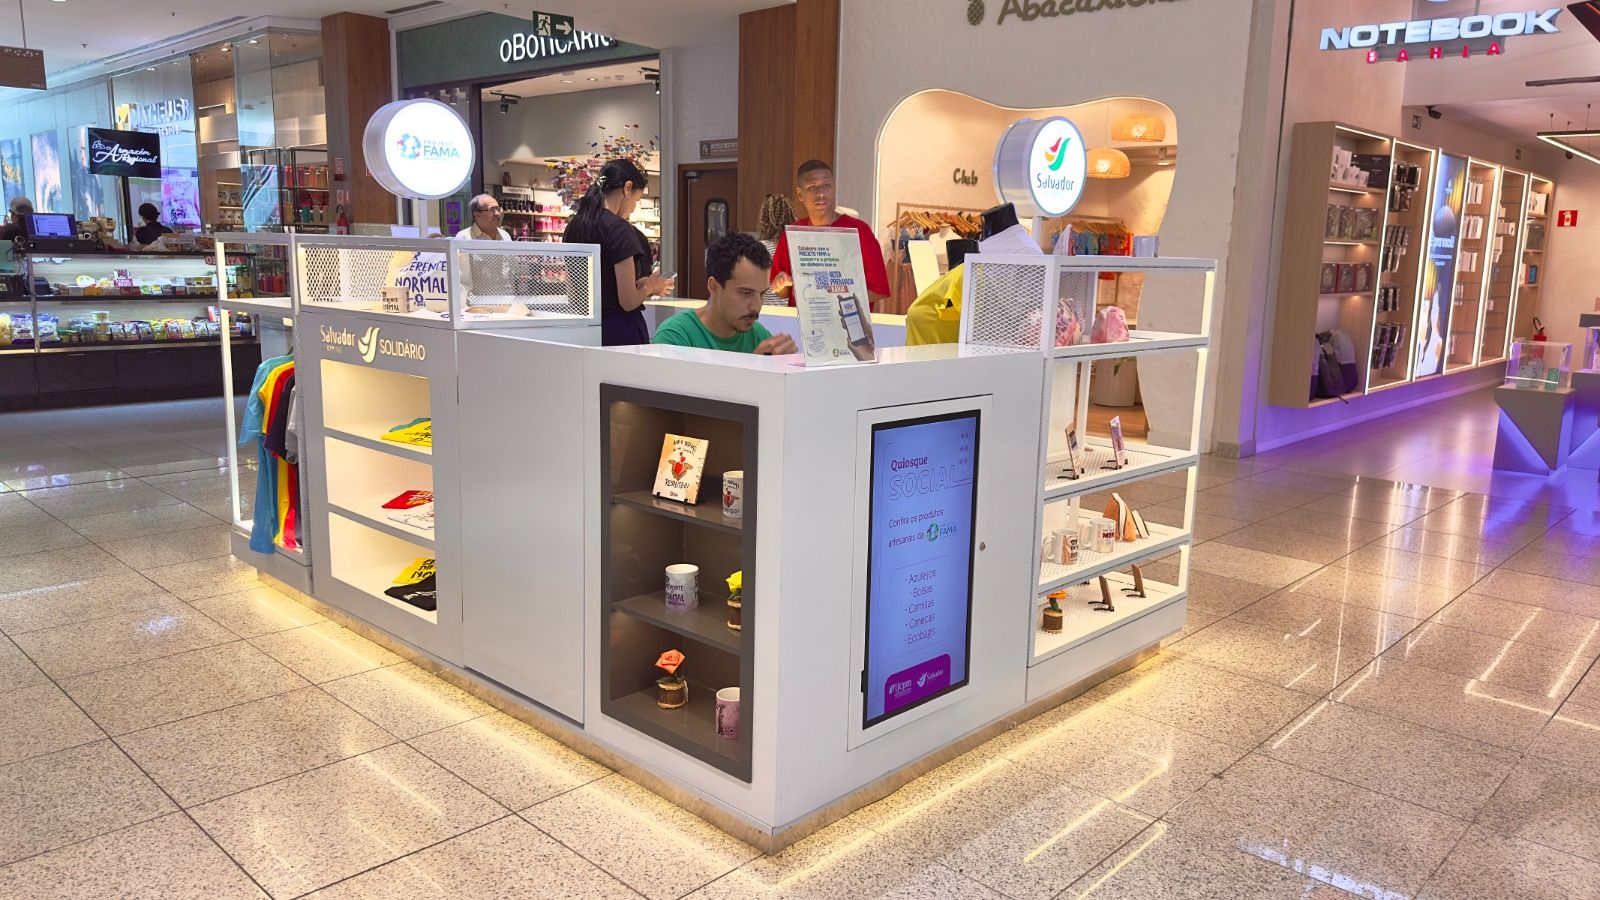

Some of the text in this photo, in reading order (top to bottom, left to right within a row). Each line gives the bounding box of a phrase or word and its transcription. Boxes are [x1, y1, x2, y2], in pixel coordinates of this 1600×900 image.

[1319, 8, 1563, 50] NOTEBOOK
[1366, 42, 1500, 64] BAHIA
[423, 145, 460, 158] FAMA
[953, 167, 978, 186] Club
[1036, 172, 1075, 191] Salvador
[394, 275, 448, 294] NORMAL
[320, 324, 426, 361] Salvador SOLIDÁRIO
[890, 456, 928, 471] Quiosque
[889, 464, 974, 501] SOCIAL
[888, 517, 910, 529] Confira
[918, 509, 944, 523] produtos
[887, 534, 916, 549] artesanais
[939, 525, 958, 536] FAMA
[908, 569, 937, 584] Azulejos
[913, 585, 934, 598] Bolsas
[908, 599, 935, 614] Camisas
[909, 613, 936, 629] Canecas
[907, 628, 936, 645] Ecobags
[926, 669, 944, 680] Salvador
